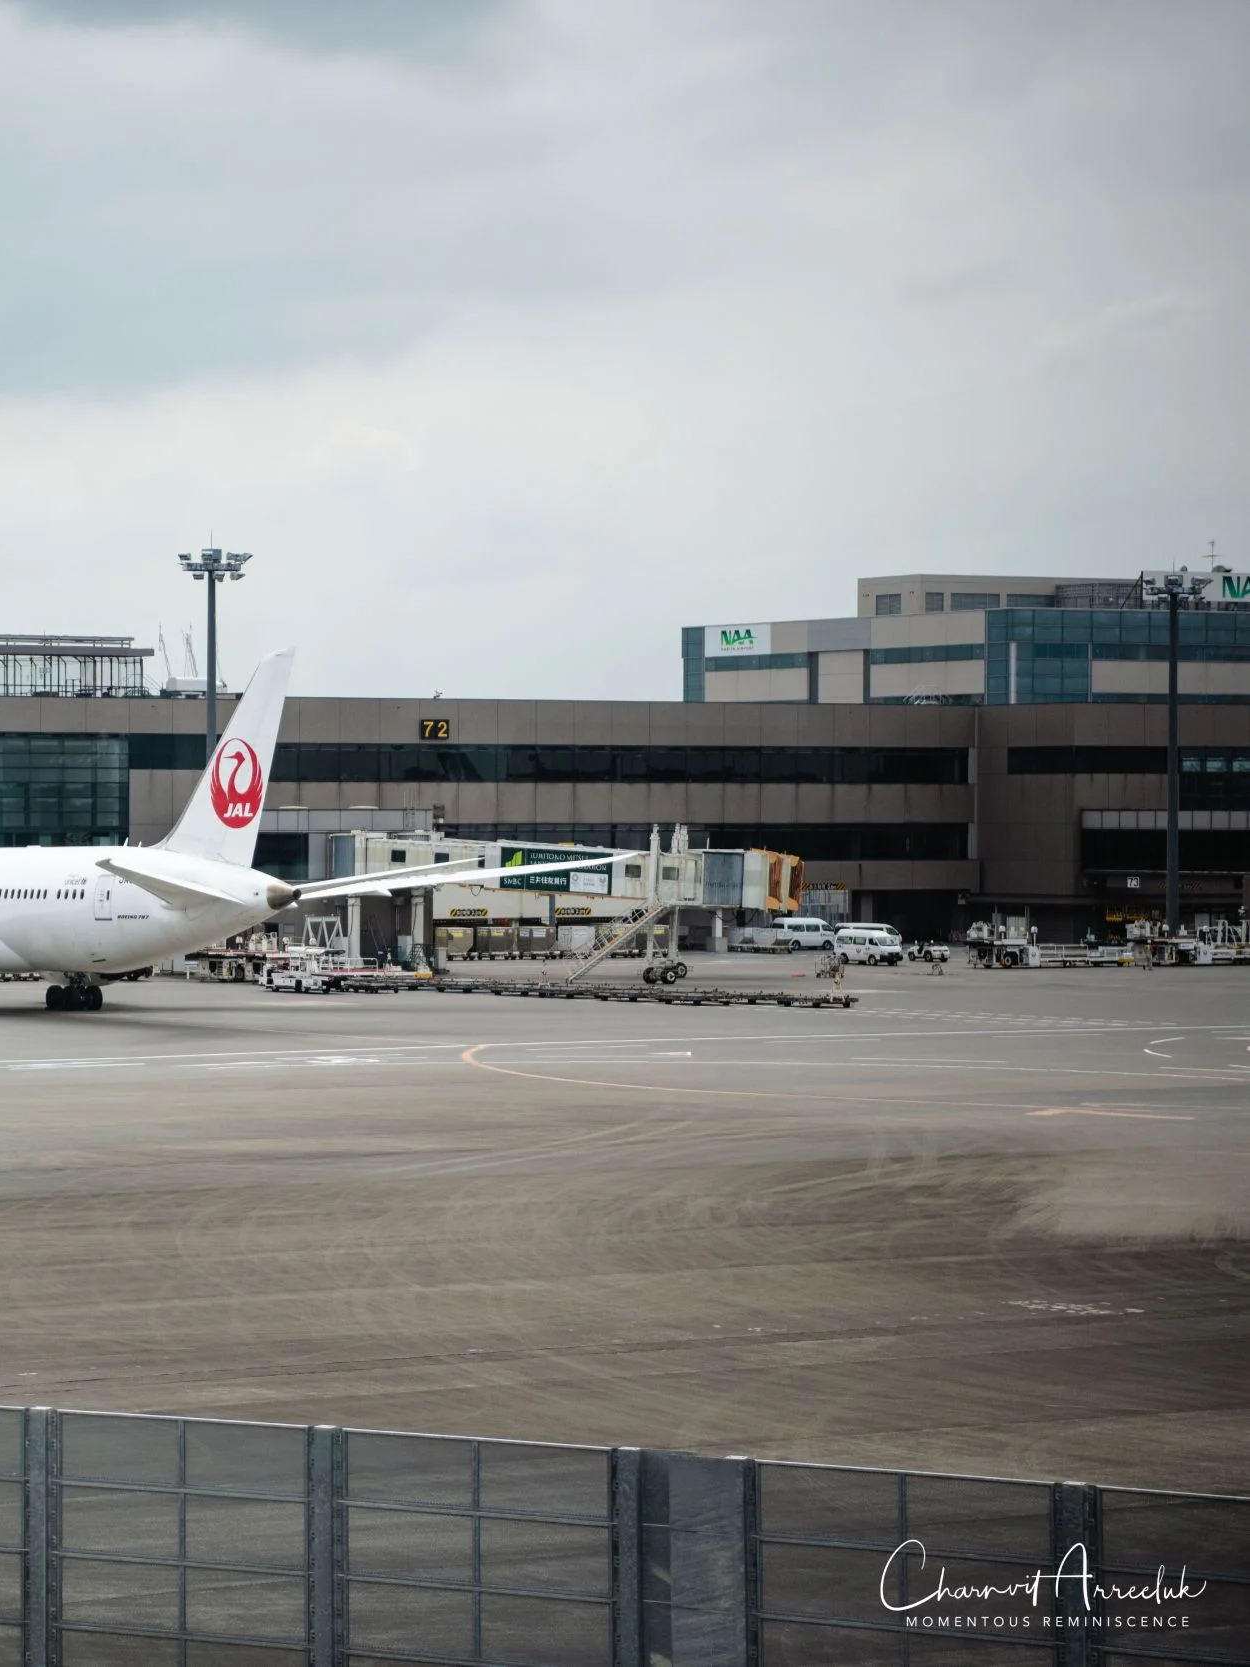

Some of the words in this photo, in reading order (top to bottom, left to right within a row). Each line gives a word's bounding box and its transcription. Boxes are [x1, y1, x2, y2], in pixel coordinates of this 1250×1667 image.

[721, 629, 758, 645] NAA
[423, 721, 448, 737] 72
[223, 802, 253, 818] JAL
[503, 877, 522, 886] SMBC
[1128, 877, 1139, 888] 73
